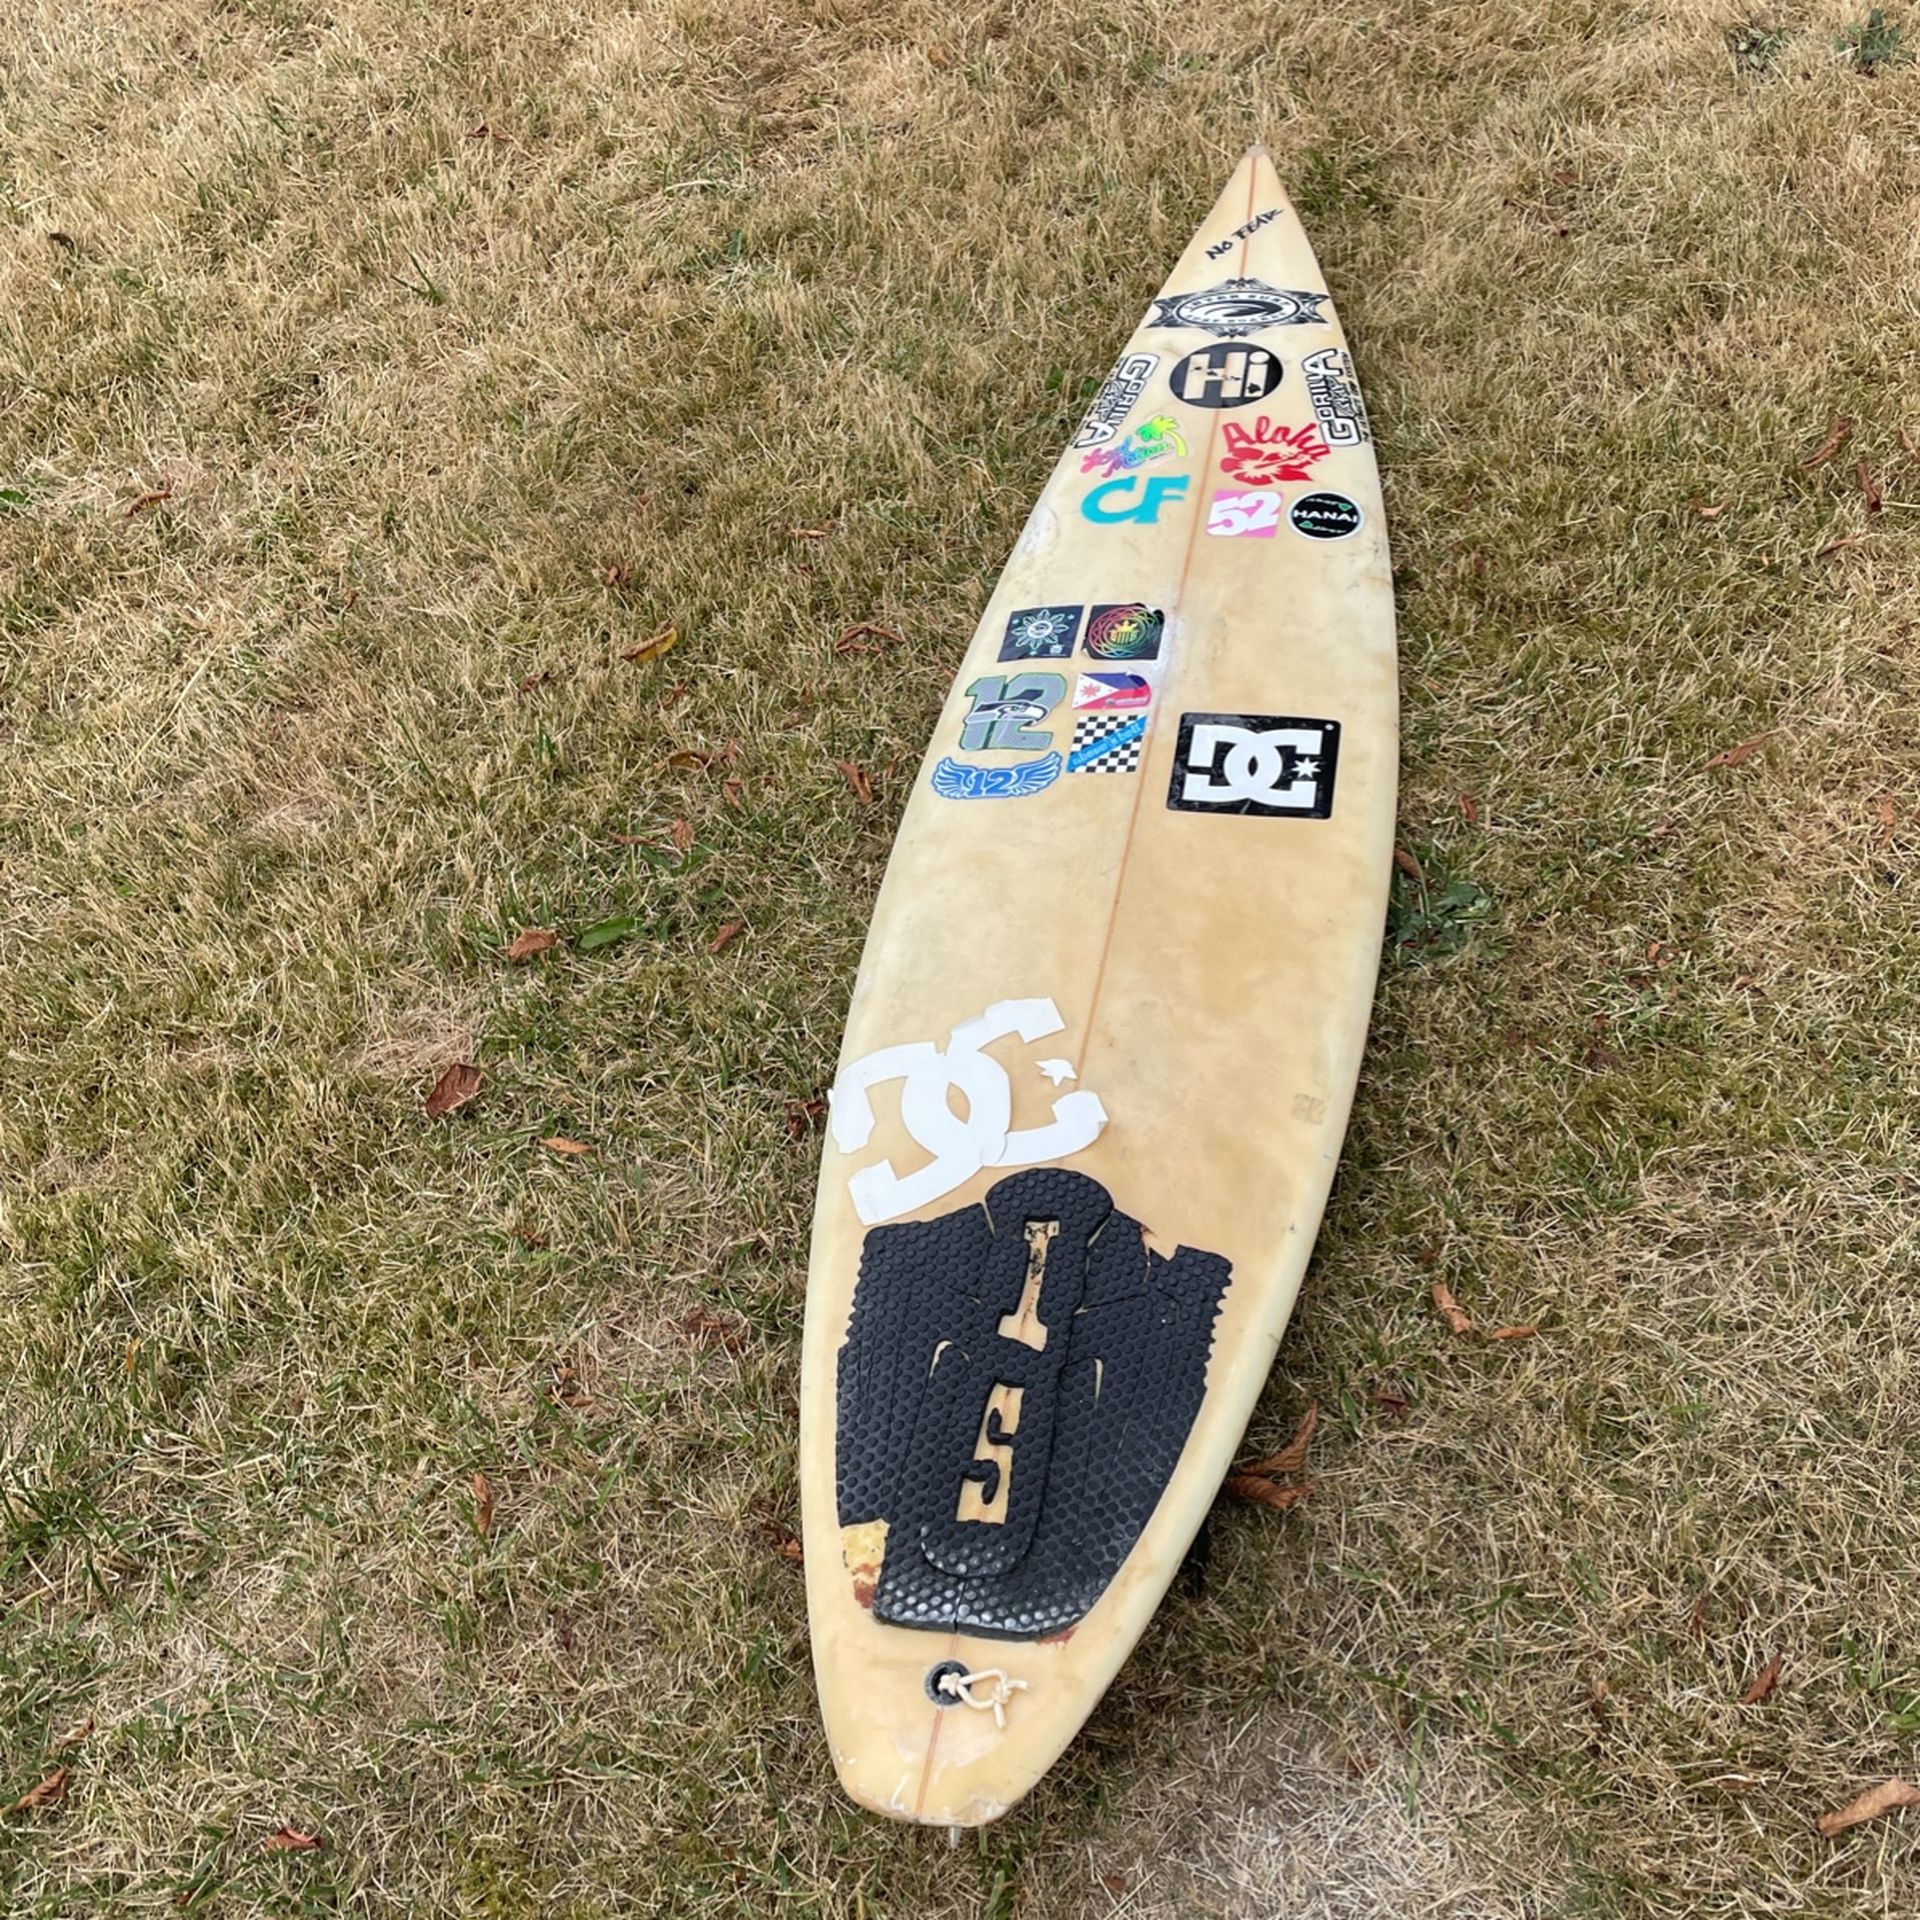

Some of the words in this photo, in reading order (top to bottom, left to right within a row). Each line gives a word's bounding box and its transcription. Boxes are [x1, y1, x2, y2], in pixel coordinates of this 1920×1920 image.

[1231, 208, 1285, 240] FEAR
[1073, 352, 1160, 448] GORILLA
[1183, 350, 1270, 400] Hi
[1301, 348, 1361, 447] GORILLA
[1222, 415, 1331, 462] Aloha
[1080, 474, 1190, 524] CF
[1207, 490, 1281, 537] 52
[1293, 509, 1358, 523] HANAI
[959, 672, 1067, 751] 12
[968, 769, 1013, 796] 12
[1182, 724, 1323, 808] DC
[828, 998, 1108, 1226] DC
